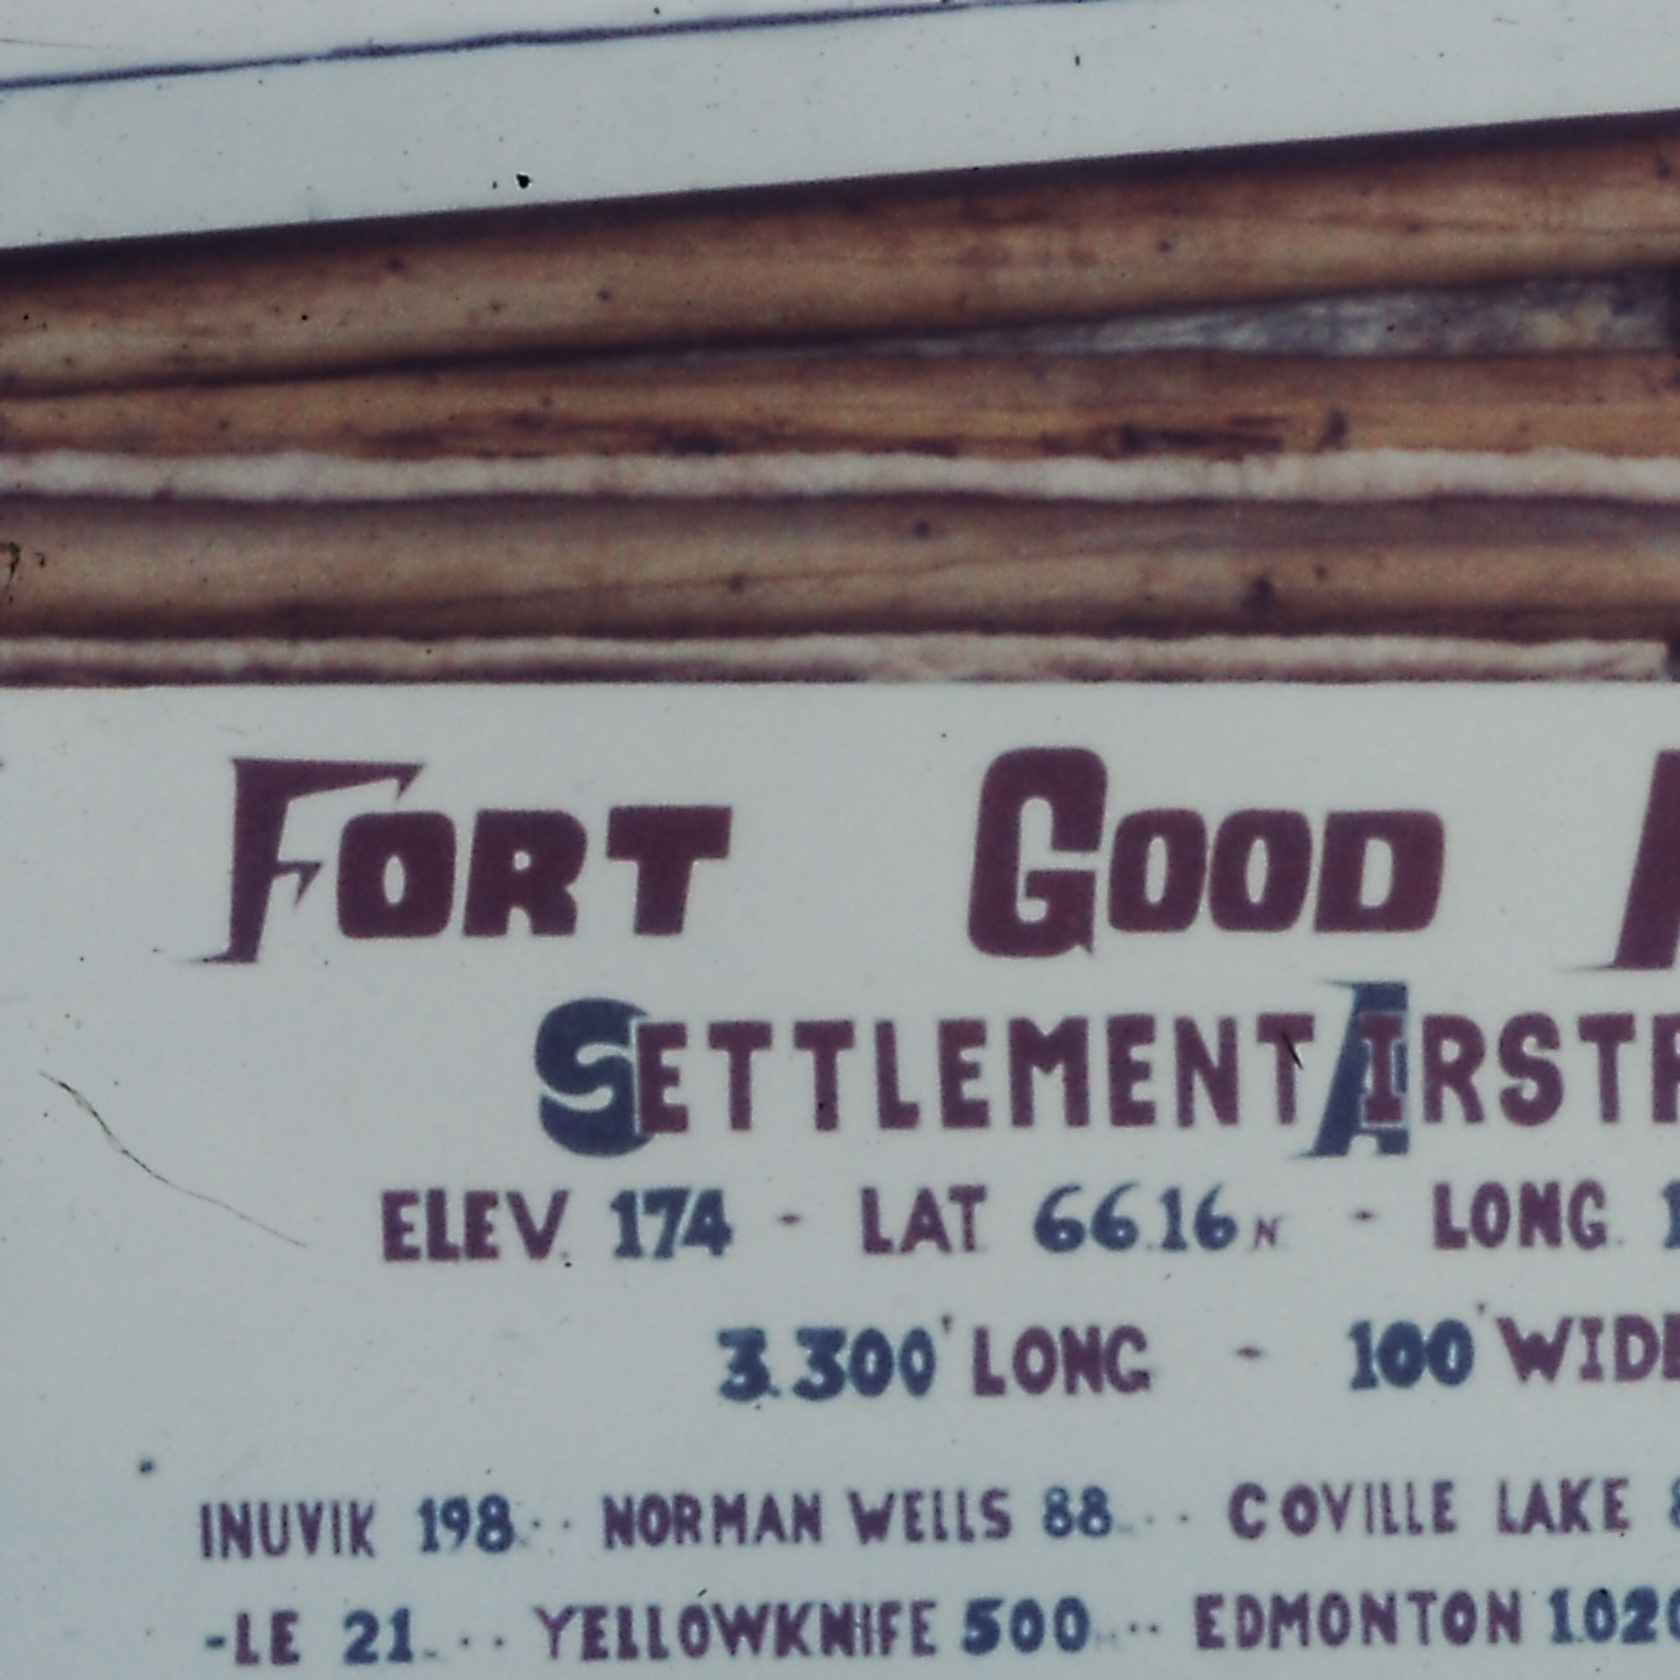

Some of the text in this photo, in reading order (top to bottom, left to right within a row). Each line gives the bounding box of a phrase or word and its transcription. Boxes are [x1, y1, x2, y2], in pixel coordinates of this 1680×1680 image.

[198, 755, 735, 967] FORT
[965, 744, 1447, 961] GOOD
[532, 996, 1316, 1160] SETTLEMENT
[608, 1185, 735, 1262] 174
[970, 1323, 1153, 1399] LONG
[198, 1498, 377, 1562] INUVIK
[415, 1491, 518, 1556] 198
[600, 1490, 824, 1552] NORMAN
[845, 1486, 1014, 1547] WELLS
[1040, 1483, 1116, 1541] 88
[1225, 1478, 1459, 1543] COVILLE
[1495, 1475, 1632, 1539] LAKE
[341, 1605, 416, 1668] 21
[532, 1598, 939, 1664] YELLOWKNIFE
[959, 1594, 1093, 1658] 500
[1192, 1587, 1524, 1653] EDMONTON
